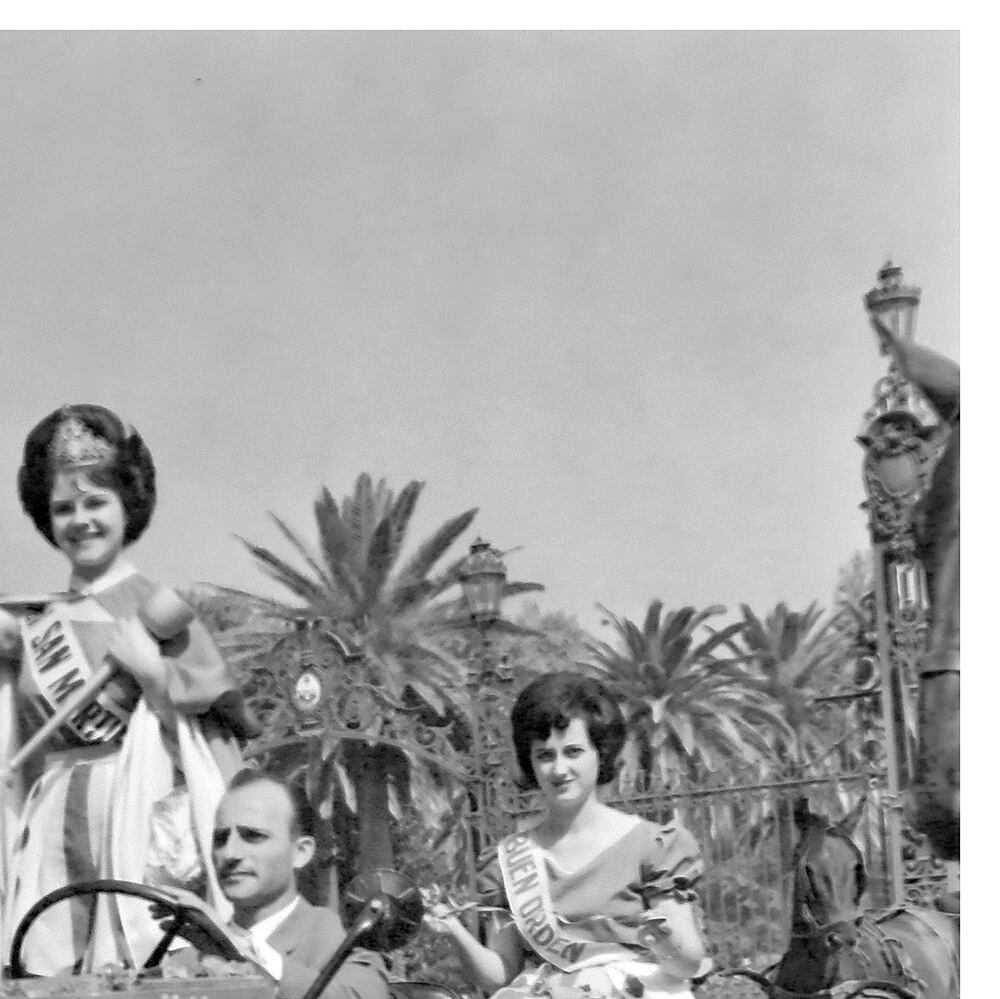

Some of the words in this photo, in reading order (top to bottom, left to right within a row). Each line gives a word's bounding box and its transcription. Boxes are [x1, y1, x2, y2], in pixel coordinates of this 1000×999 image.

[31, 620, 72, 674] SAN
[504, 834, 541, 895] BUEN
[519, 896, 586, 963] ORDEN
